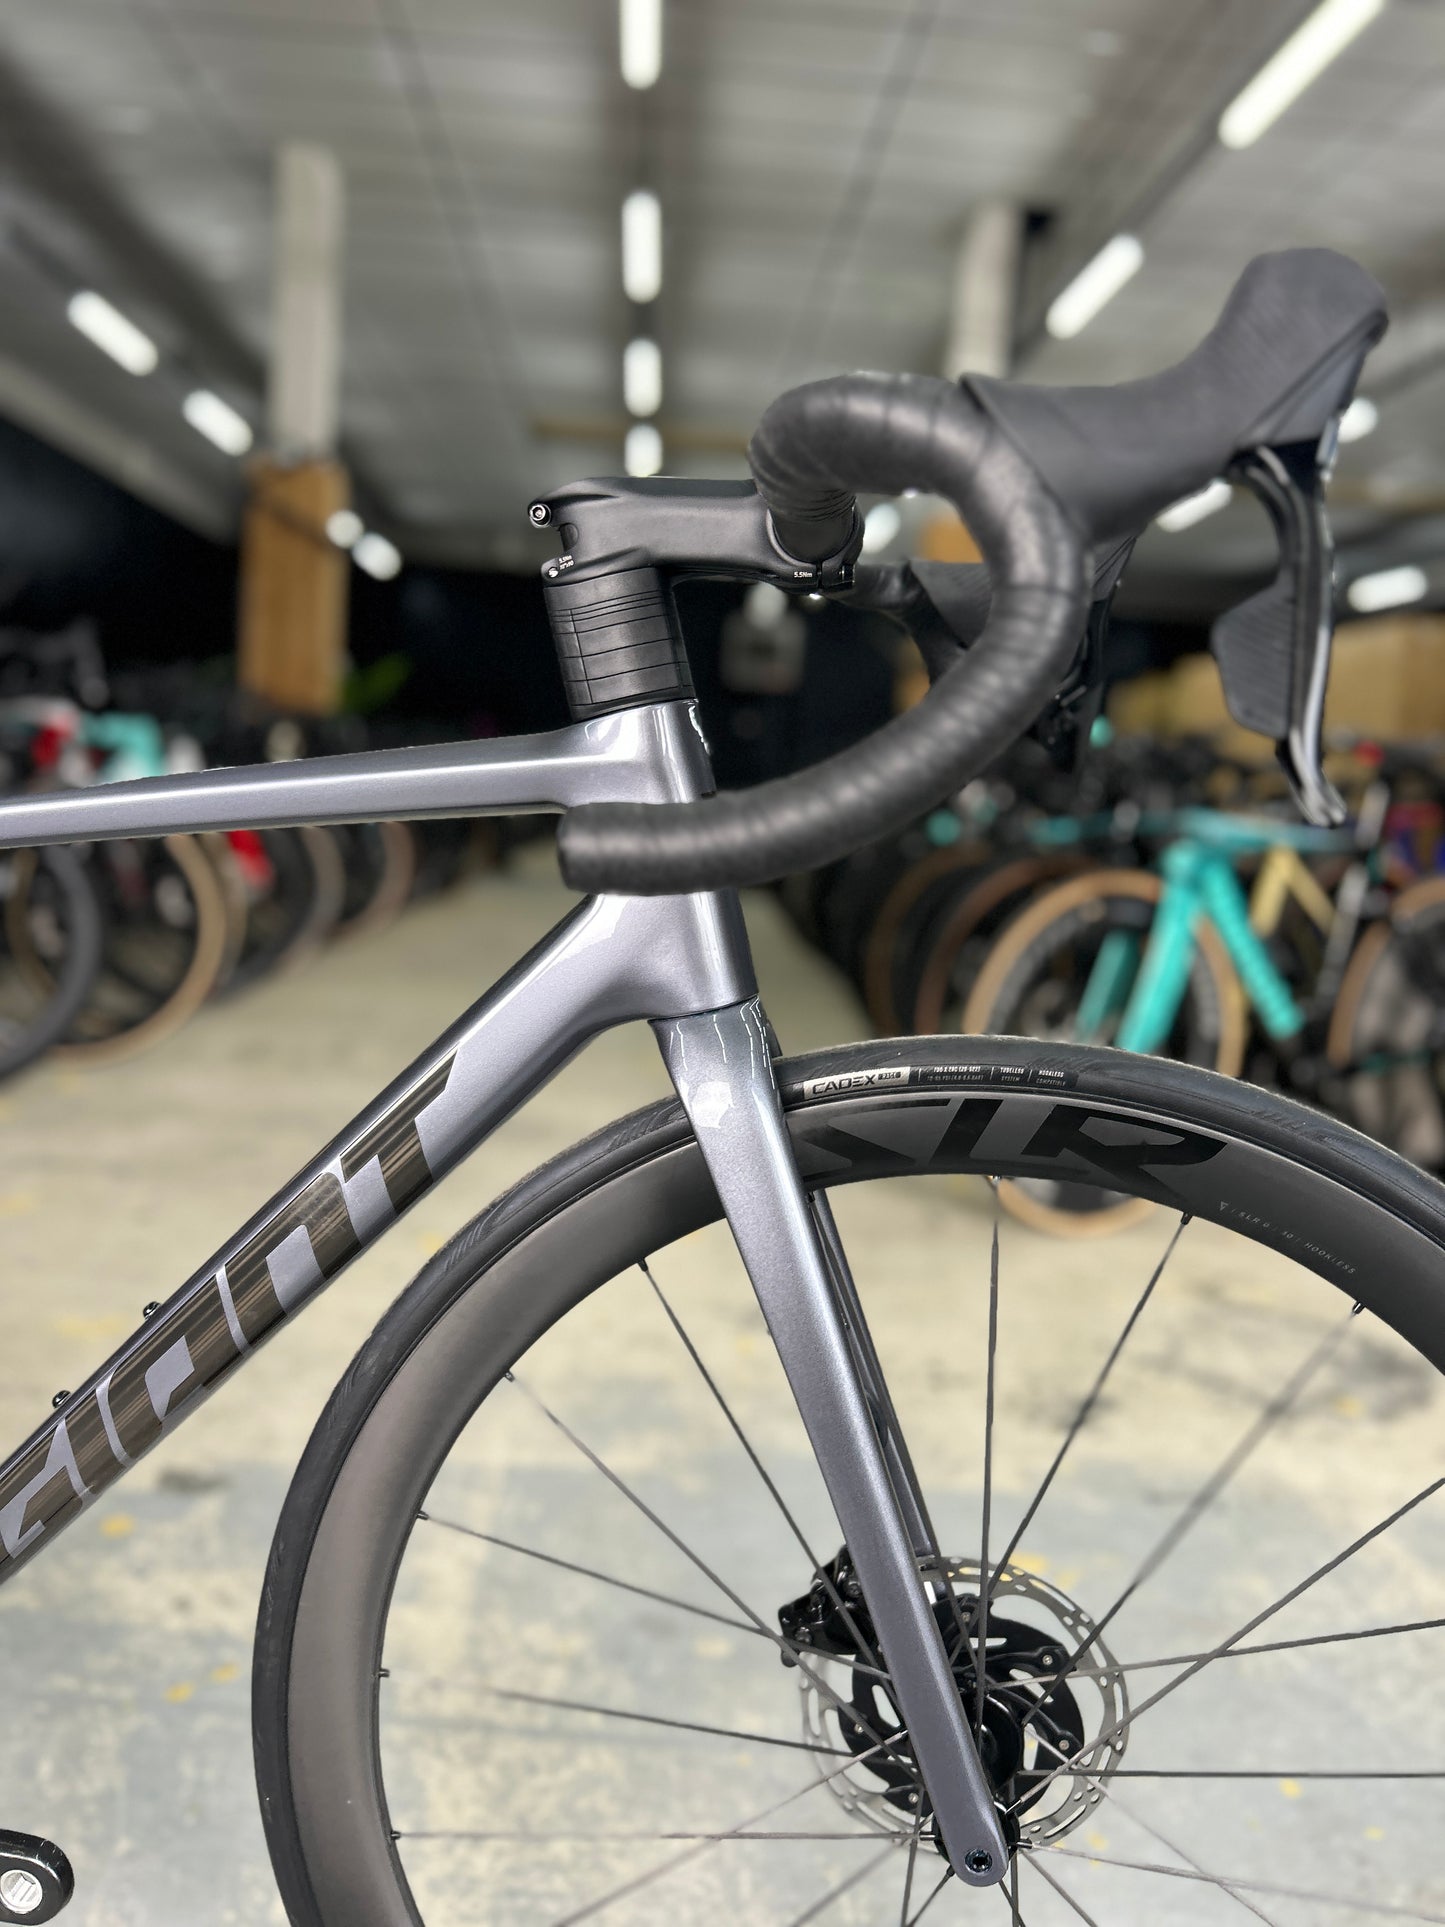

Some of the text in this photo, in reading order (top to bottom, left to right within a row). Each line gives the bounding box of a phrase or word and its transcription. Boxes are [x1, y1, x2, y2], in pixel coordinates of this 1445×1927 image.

[1000, 1067, 1025, 1075] TUBELESS
[1038, 1070, 1065, 1078] HOOKLESS
[812, 1074, 877, 1095] CADEX
[788, 1098, 1228, 1201] SLR
[1304, 1242, 1357, 1275] HOOKLESS
